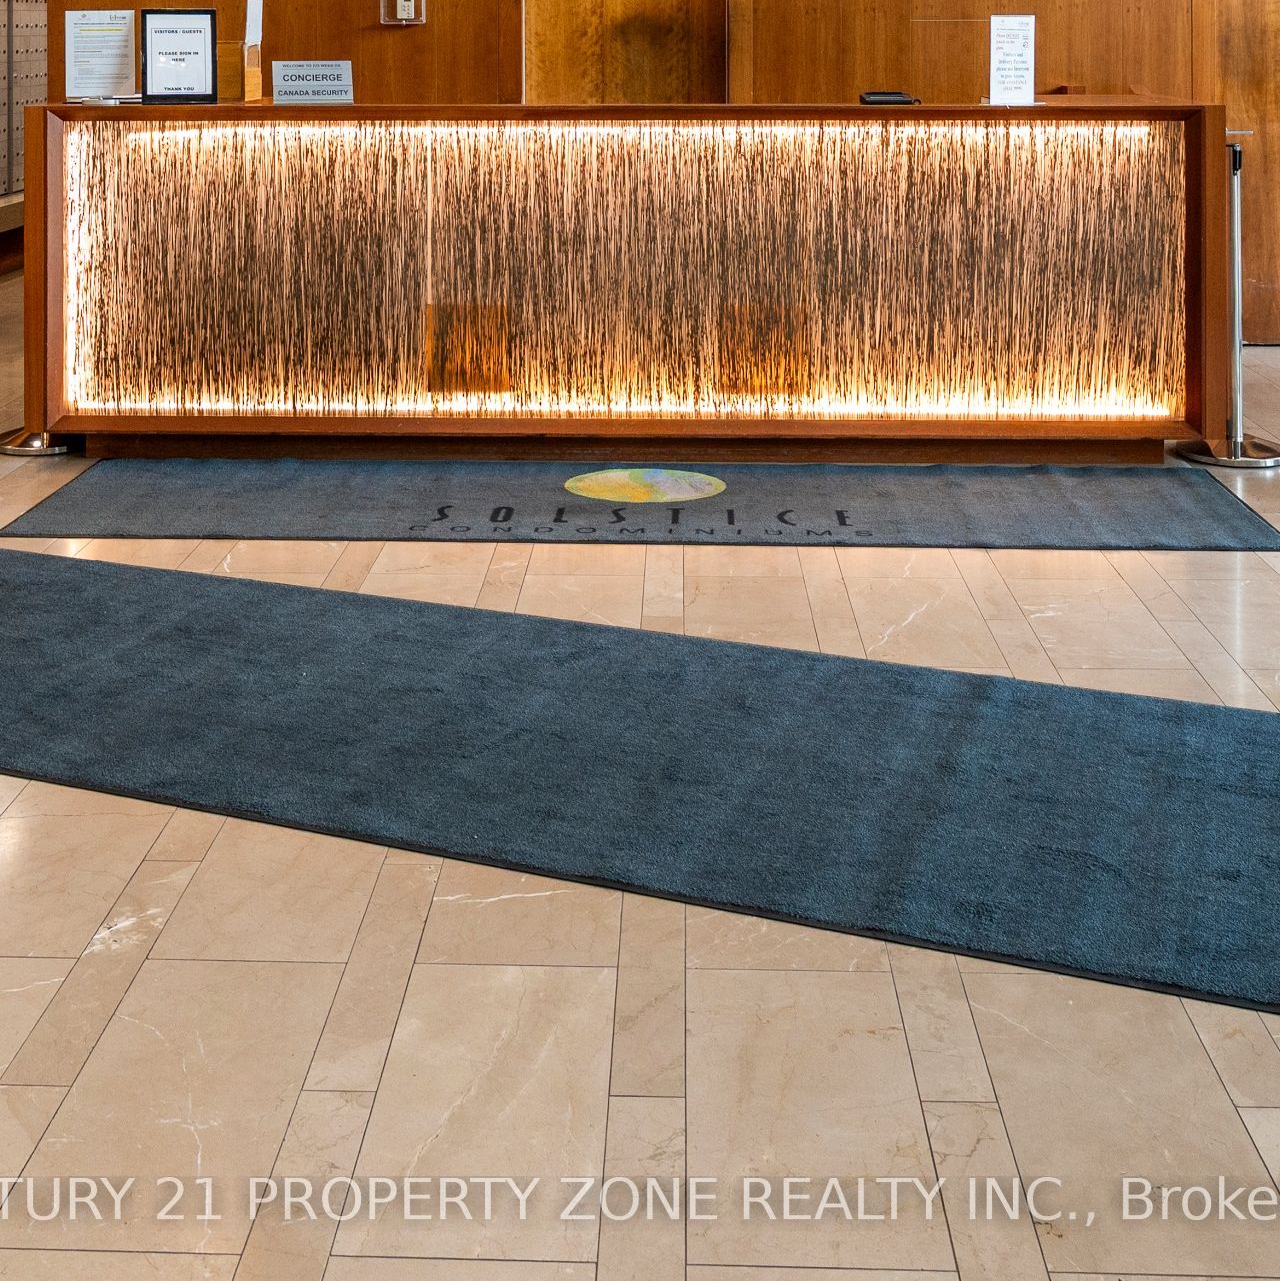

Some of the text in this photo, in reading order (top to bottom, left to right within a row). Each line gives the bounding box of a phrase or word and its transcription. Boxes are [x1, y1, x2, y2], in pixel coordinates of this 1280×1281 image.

[282, 73, 343, 82] CONCIERGE
[430, 504, 856, 528] SOLSTICE
[407, 523, 875, 538] CONDOMINIUMS
